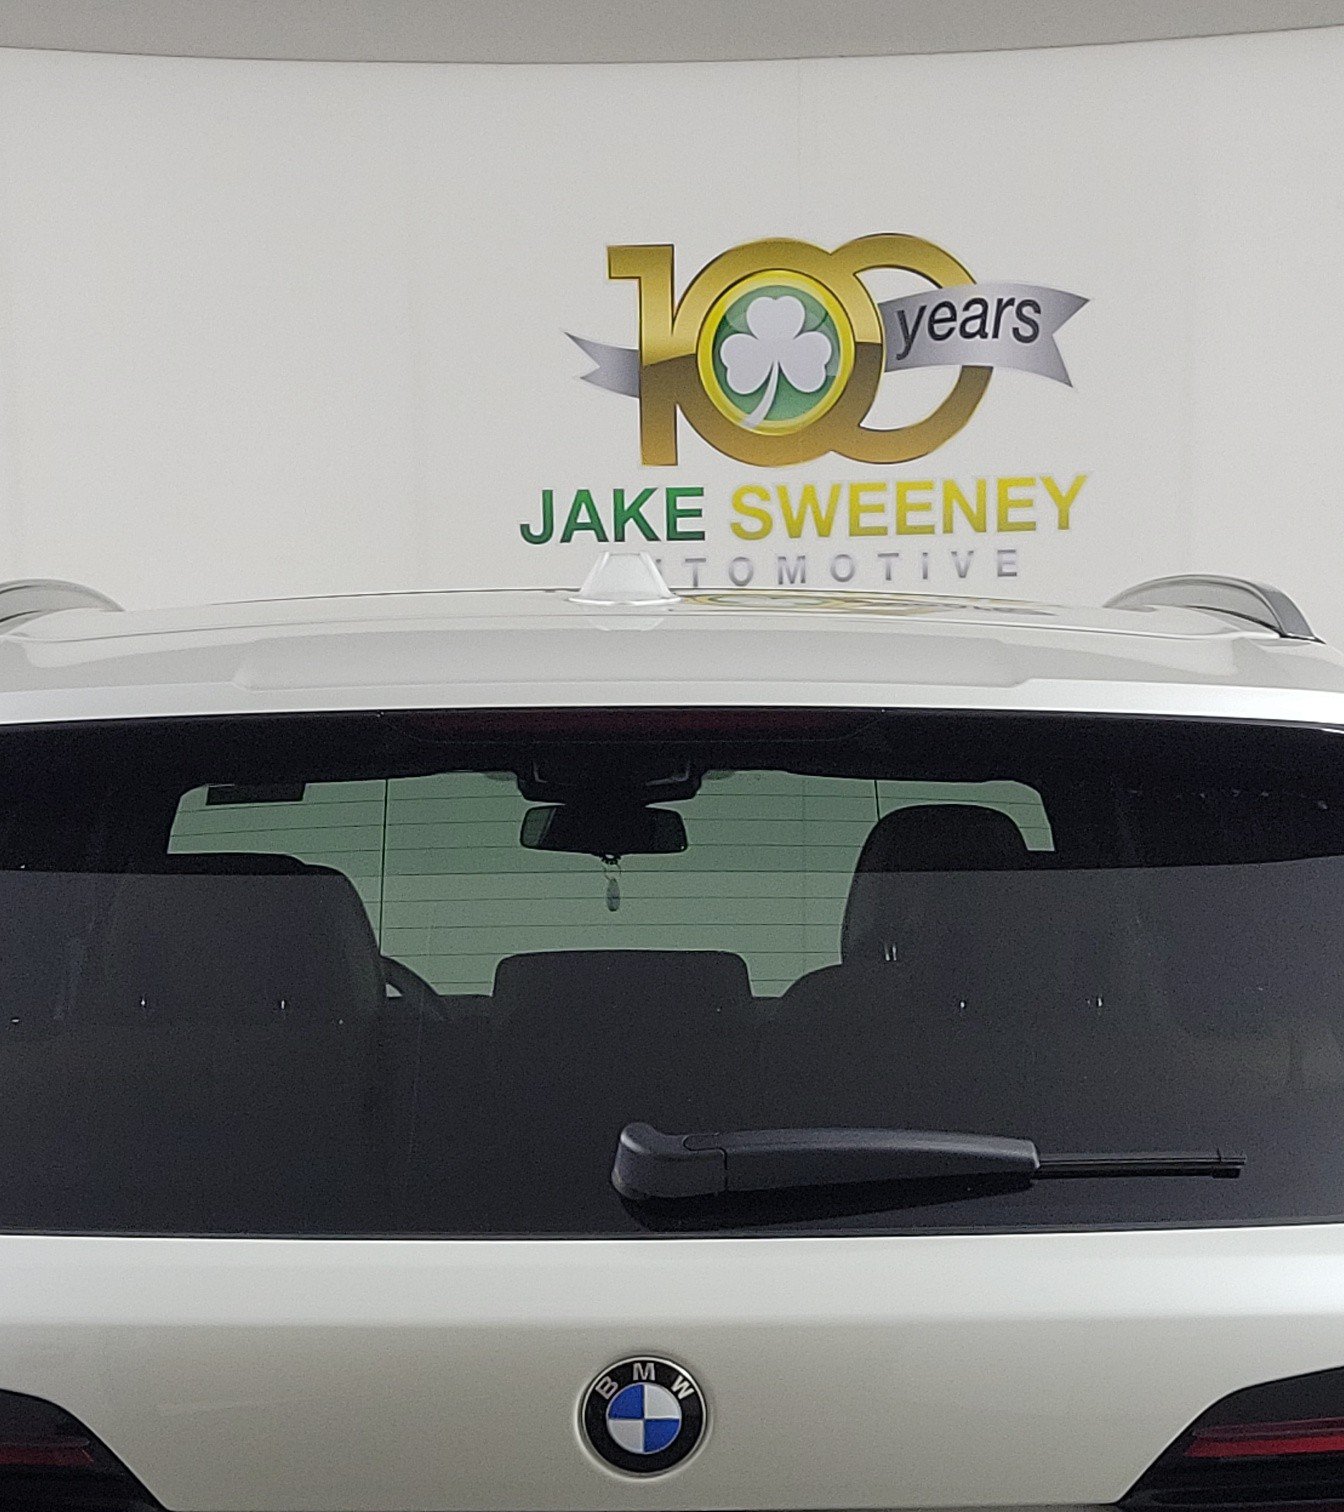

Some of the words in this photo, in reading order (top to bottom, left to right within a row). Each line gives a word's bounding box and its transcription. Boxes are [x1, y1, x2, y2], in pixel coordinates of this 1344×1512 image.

[606, 233, 993, 467] 100
[895, 296, 1041, 361] years
[519, 486, 706, 546] JAKE
[729, 474, 1088, 541] SWEENEY
[595, 1362, 695, 1400] BMW
